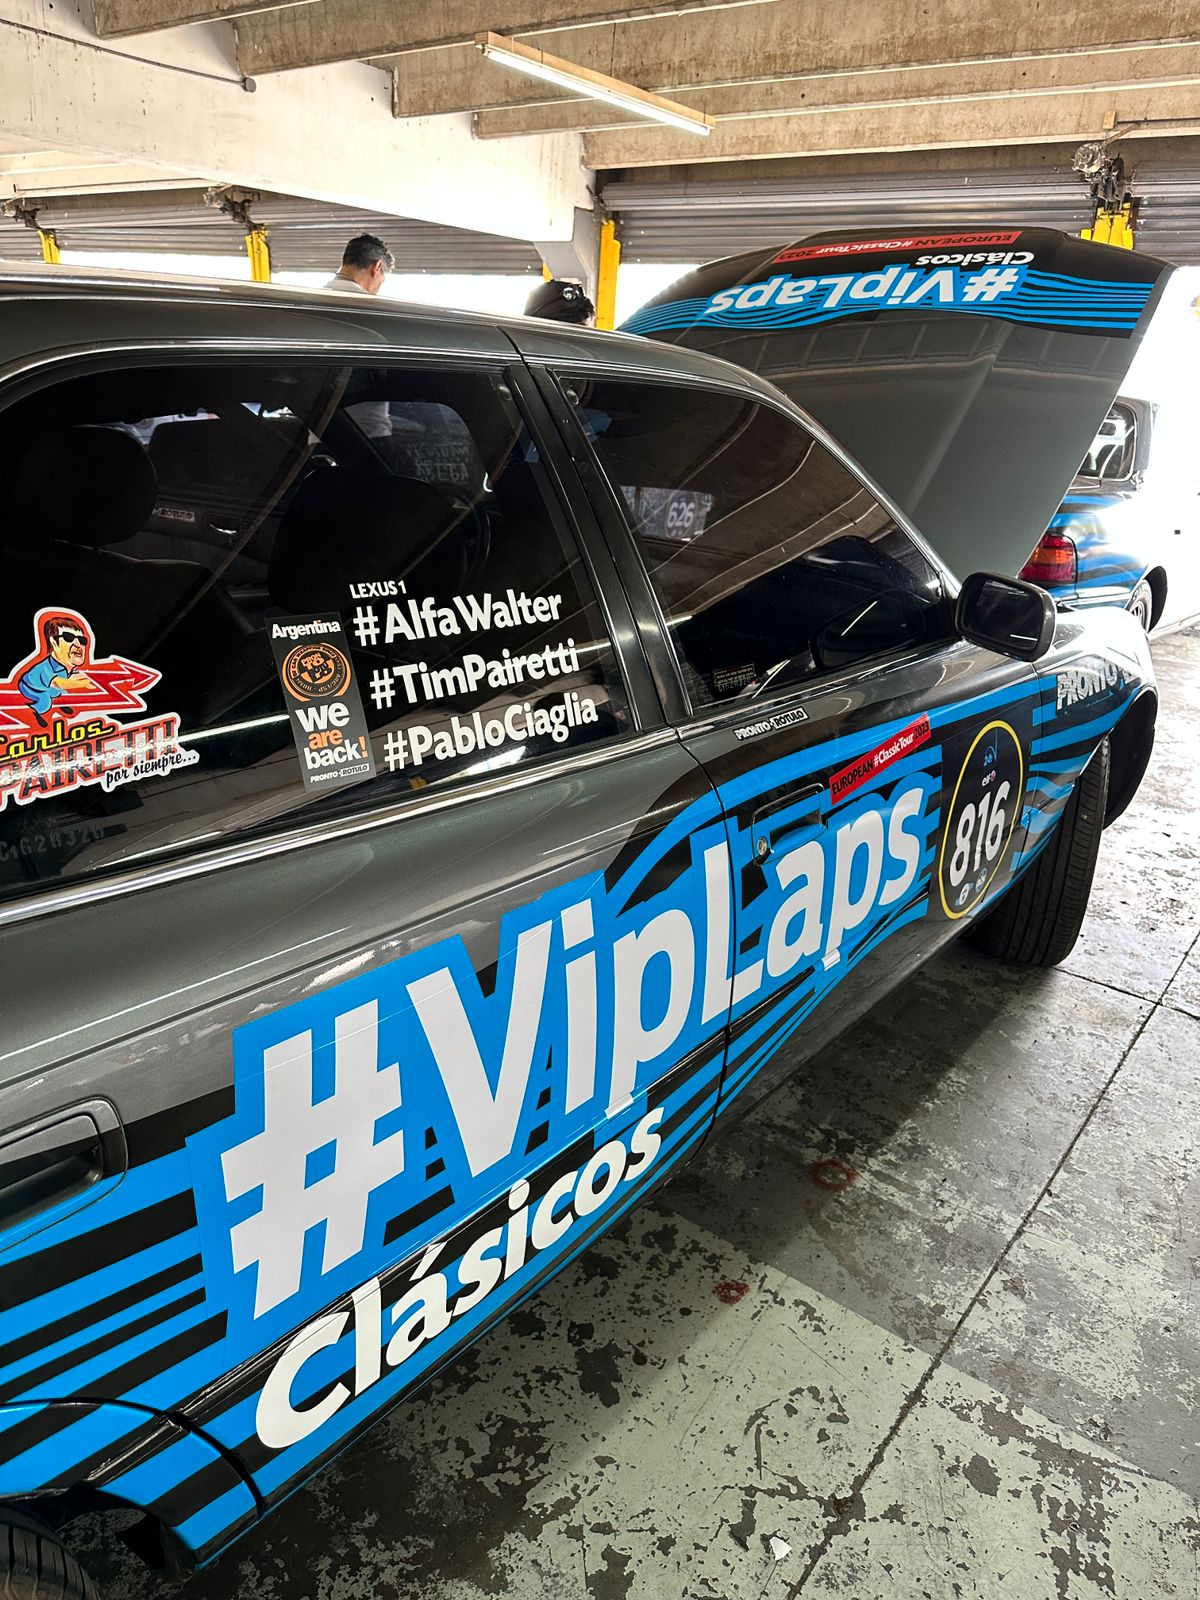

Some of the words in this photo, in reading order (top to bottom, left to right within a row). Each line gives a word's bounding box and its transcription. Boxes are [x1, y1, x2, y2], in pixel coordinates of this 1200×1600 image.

[779, 250, 814, 260] 2023
[816, 239, 915, 254] #ClassicTour
[915, 232, 1013, 247] EUROPEAN
[916, 252, 1035, 266] Clásicos
[703, 266, 1020, 314] #VipLaps
[667, 502, 695, 528] 626
[350, 581, 398, 599] LEXUS
[271, 620, 342, 640] Argentina
[352, 589, 562, 646] #AlfaWalter
[369, 637, 581, 710] #TimPairetti
[1056, 663, 1118, 711] PRONTO
[294, 702, 350, 733] we
[383, 692, 599, 772] #PabloCiaglia
[734, 721, 771, 740] PRONTO
[774, 709, 805, 728] ROTULO
[303, 735, 369, 770] back!
[308, 729, 343, 750] are
[106, 771, 129, 788] por
[133, 752, 196, 778] siempre...
[310, 771, 338, 784] PRONTO
[342, 764, 368, 776] ROTULO
[831, 759, 874, 796] EUROPEAN
[872, 733, 914, 768] #ClassicTour
[913, 720, 930, 740] 2023
[950, 780, 1011, 887] 816
[220, 787, 924, 1320] #VipLaps
[254, 1106, 667, 1449] Clásicos
